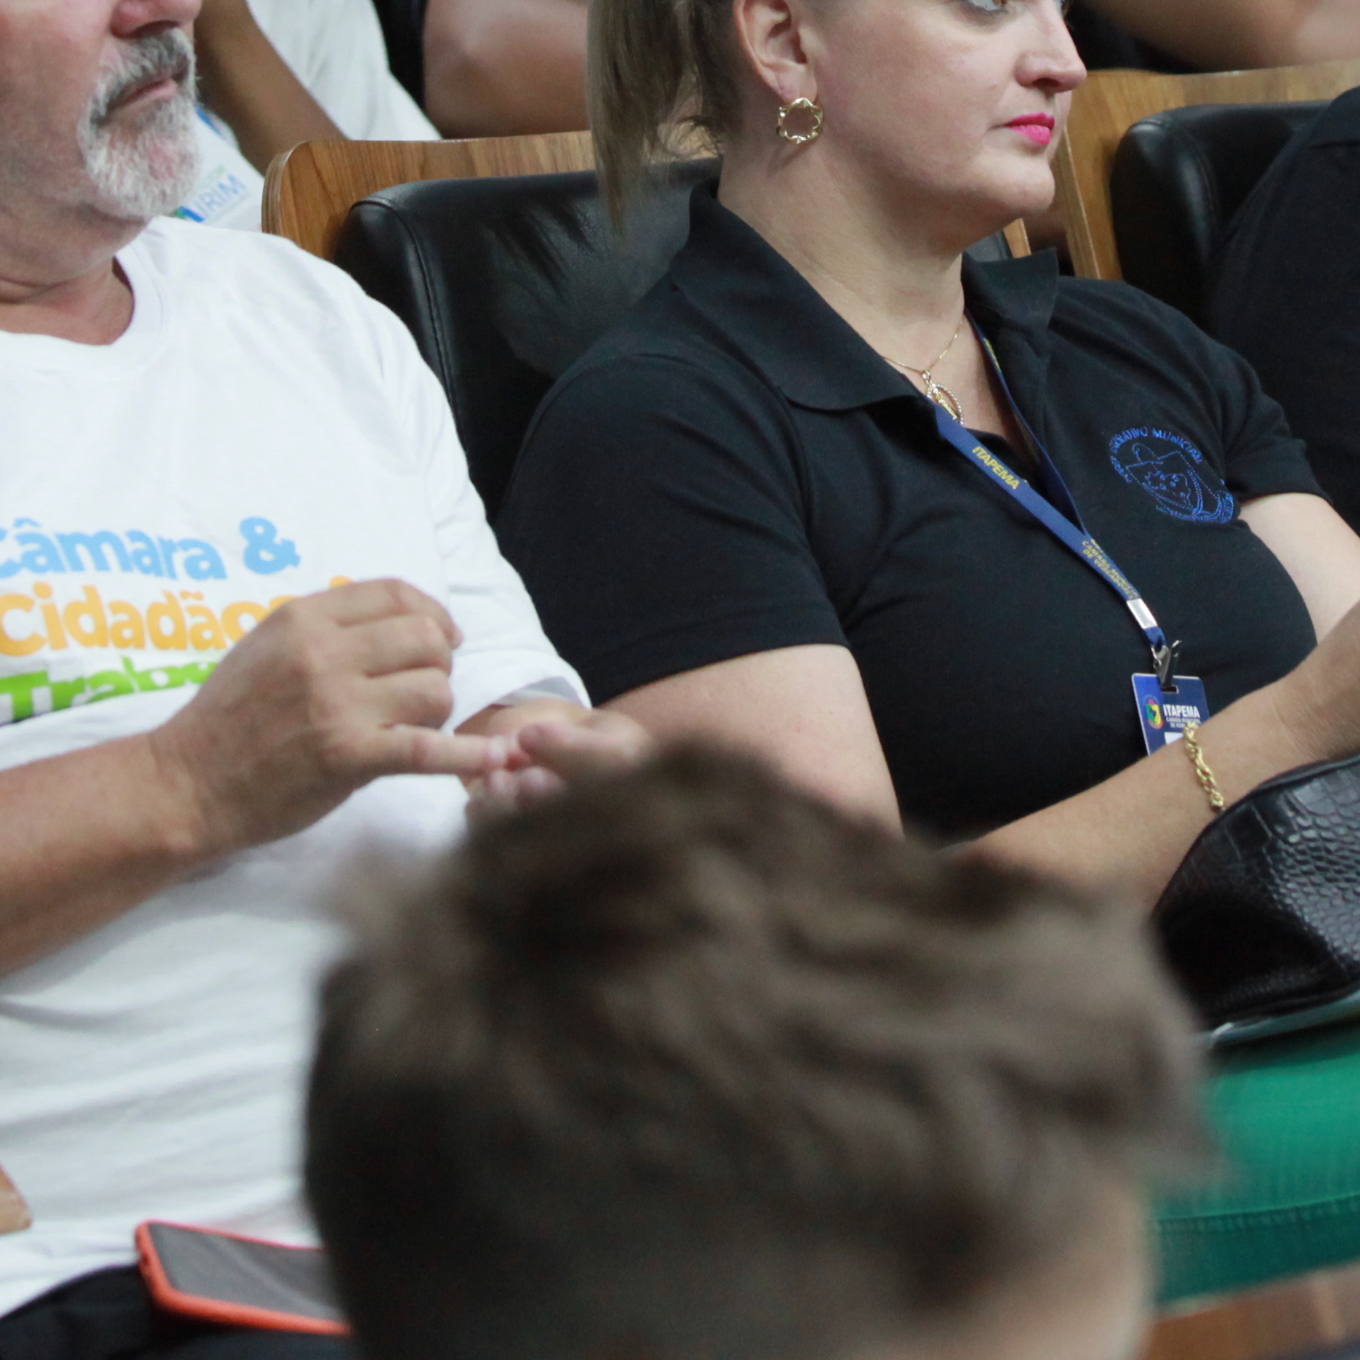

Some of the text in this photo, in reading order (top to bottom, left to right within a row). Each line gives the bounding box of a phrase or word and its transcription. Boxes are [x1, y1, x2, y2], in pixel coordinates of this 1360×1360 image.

[972, 446, 1020, 490] ITAPEMA
[239, 516, 301, 575] &
[1163, 704, 1201, 718] ITAPEMA
